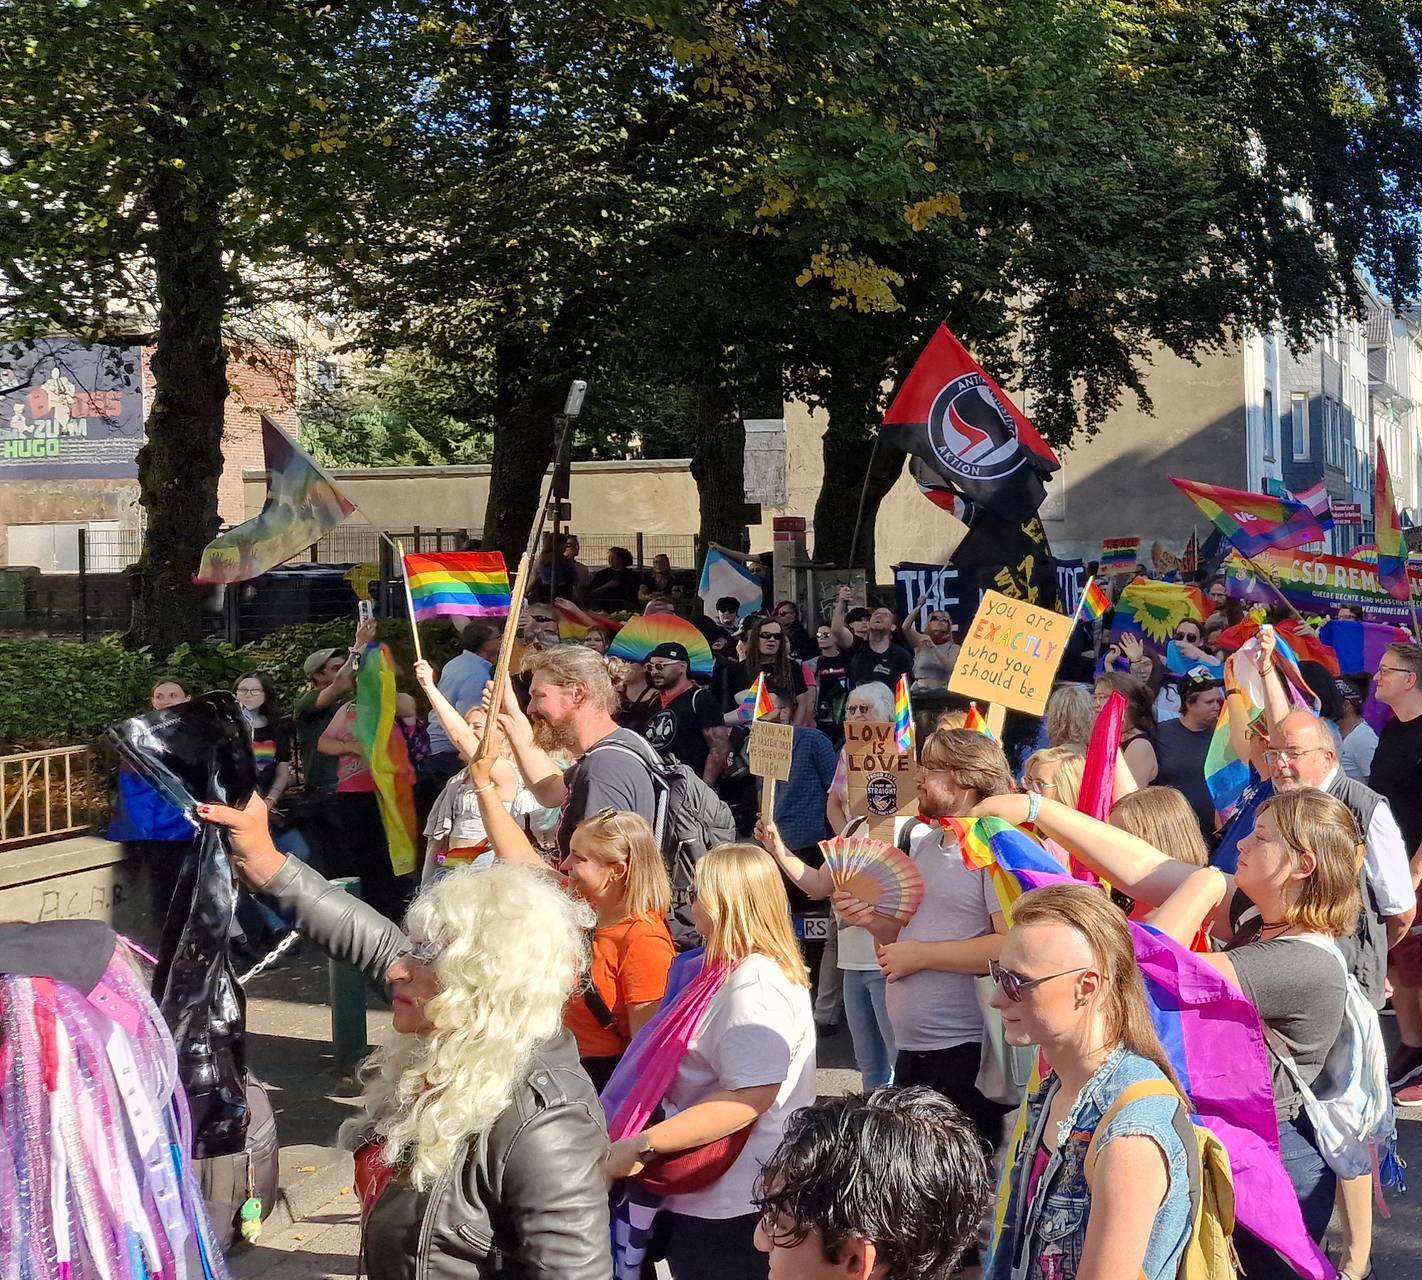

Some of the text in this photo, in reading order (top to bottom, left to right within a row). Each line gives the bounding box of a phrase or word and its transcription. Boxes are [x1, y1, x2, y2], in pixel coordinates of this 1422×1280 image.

[4, 438, 59, 458] HUGO
[938, 445, 980, 476] AKTION
[1291, 559, 1328, 586] CSD
[897, 569, 960, 632] THE
[1335, 592, 1359, 602] RECHTE
[986, 600, 1054, 632] you are
[973, 619, 1058, 660] EXACTLY
[968, 645, 1032, 676] who you
[960, 662, 1035, 698] should be
[848, 724, 897, 742] LOV
[872, 741, 886, 755] IS
[848, 754, 909, 771] LOVE
[867, 787, 897, 795] STRAIGHT
[805, 920, 827, 936] RS
